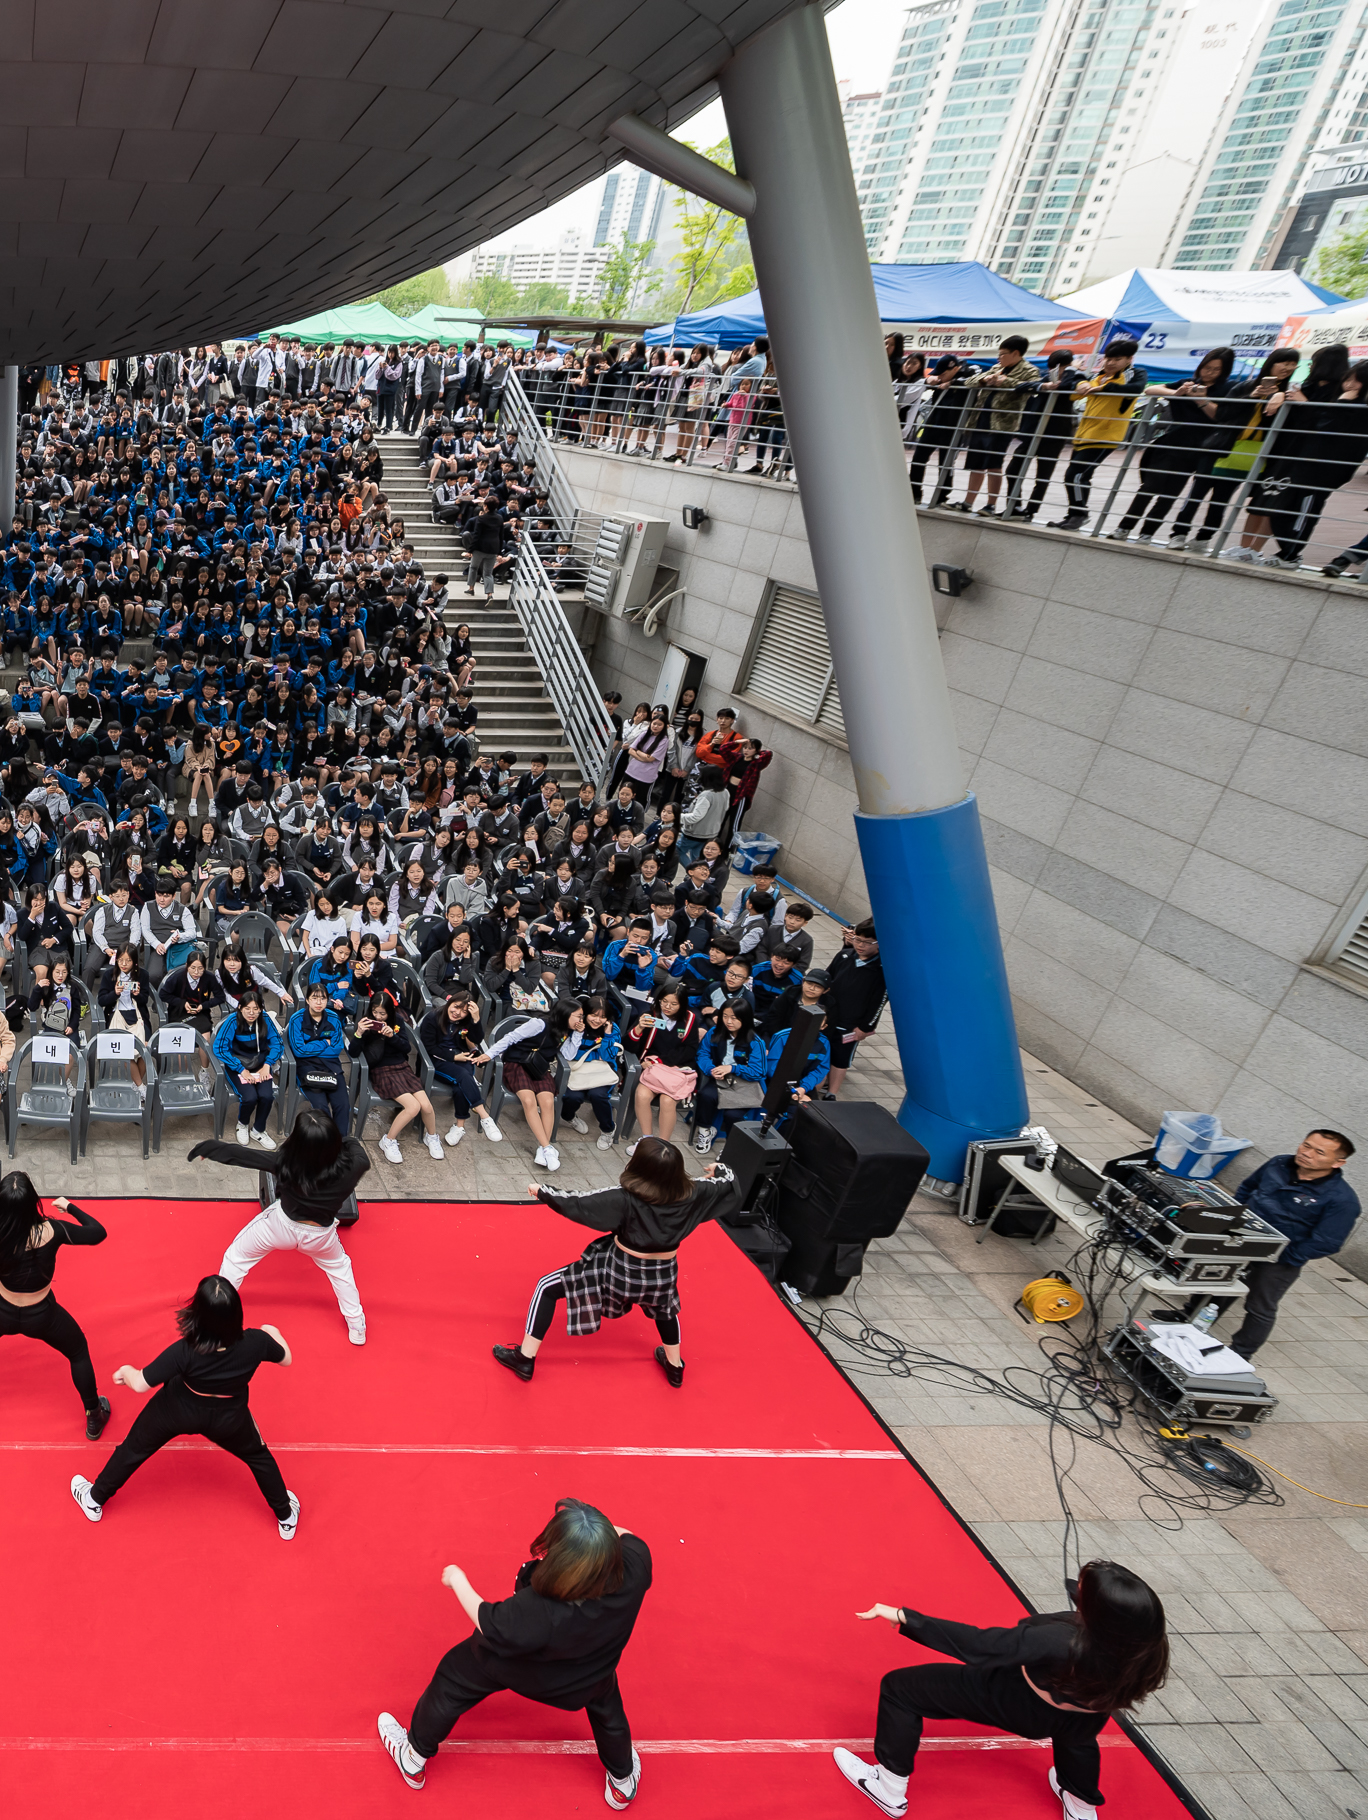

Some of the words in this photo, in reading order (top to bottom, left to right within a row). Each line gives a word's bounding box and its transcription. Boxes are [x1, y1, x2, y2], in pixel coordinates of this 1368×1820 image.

[918, 335, 955, 348] 어디쯤
[958, 334, 1003, 349] 왔을까?
[1144, 332, 1169, 350] 23
[110, 1041, 121, 1054] 빈
[171, 1036, 182, 1048] 석
[45, 1045, 57, 1058] 내
